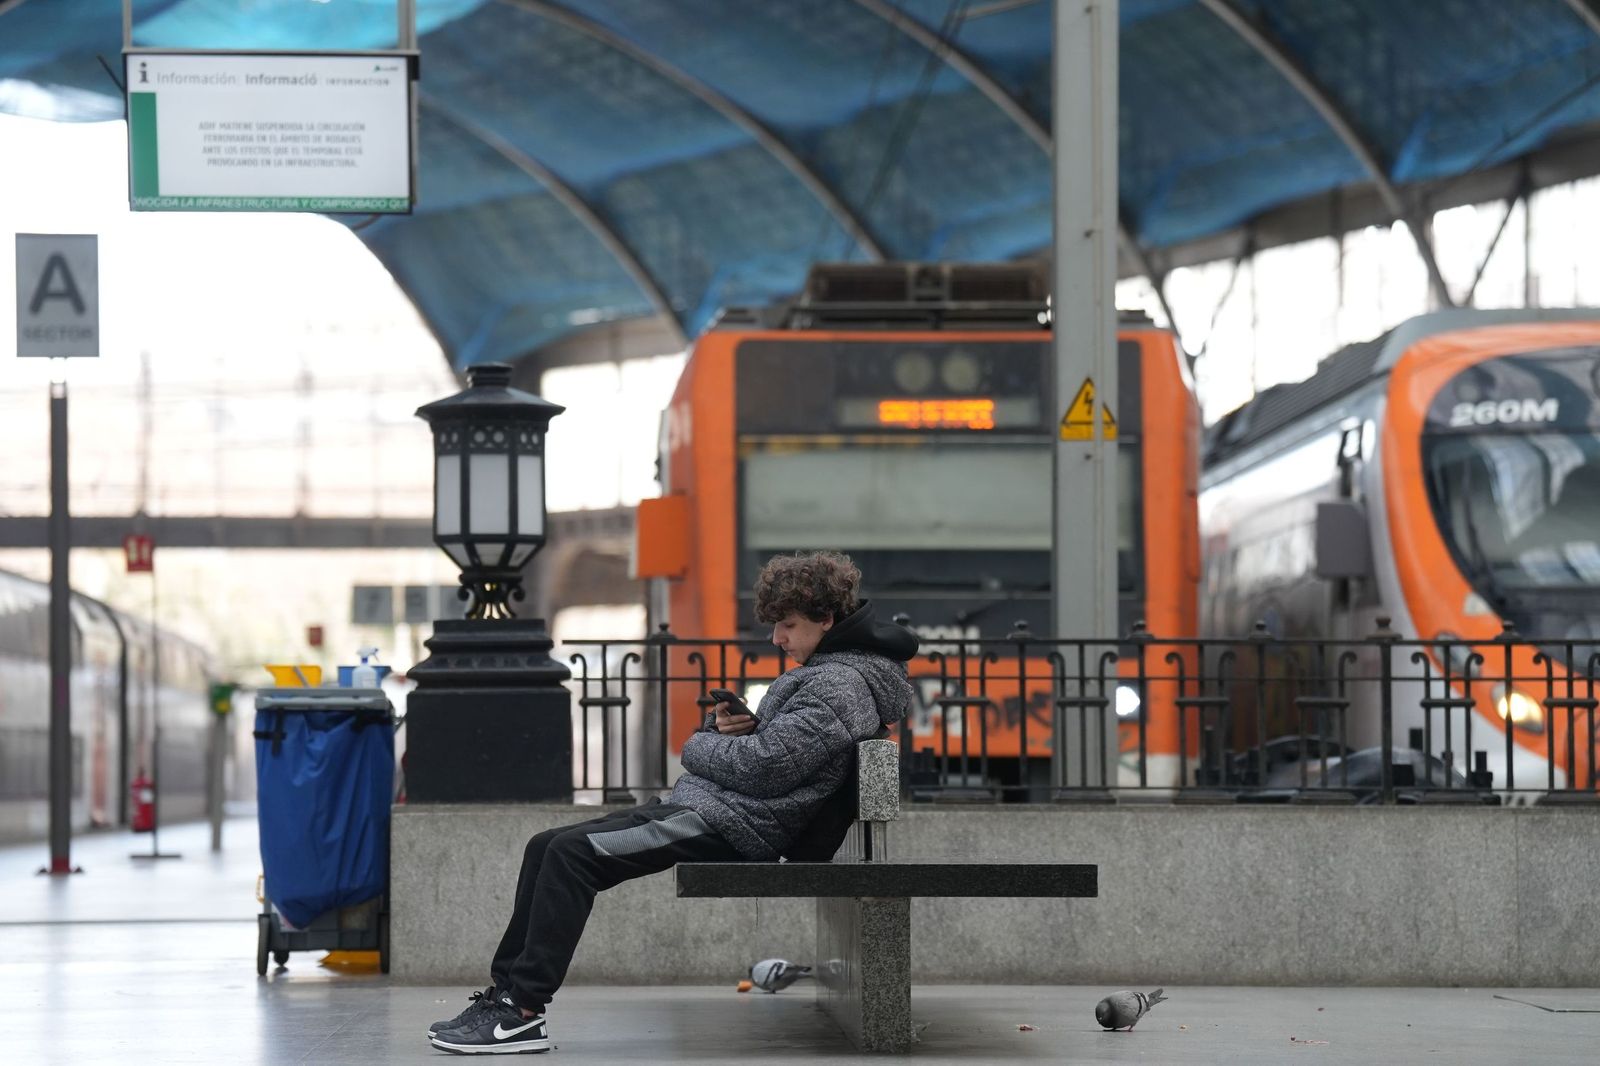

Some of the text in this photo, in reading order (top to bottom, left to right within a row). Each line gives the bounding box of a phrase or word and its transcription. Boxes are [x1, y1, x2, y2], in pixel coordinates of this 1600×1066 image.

[157, 72, 390, 87] Información Informació INFORMATION
[256, 122, 303, 131] SUSPENDIDA
[306, 122, 315, 131] LA
[203, 134, 254, 143] FERROVIARIA
[257, 134, 267, 143] EN
[269, 134, 277, 143] EL
[312, 134, 321, 143] DE
[202, 146, 221, 155] ANTE
[224, 146, 238, 155] LOS
[240, 146, 271, 155] EFECTOS
[274, 146, 289, 155] QUE
[291, 146, 300, 155] EL
[303, 146, 341, 155] TEMPORAL
[207, 158, 258, 168] PROVOCANDO
[261, 158, 271, 168] EN
[274, 158, 282, 168] LA
[180, 199, 195, 208] LA
[196, 199, 299, 209] INFRAESTRUCTURA
[310, 199, 387, 210] COMPROBADO
[29, 251, 86, 317] A
[1449, 398, 1559, 428] 260M
